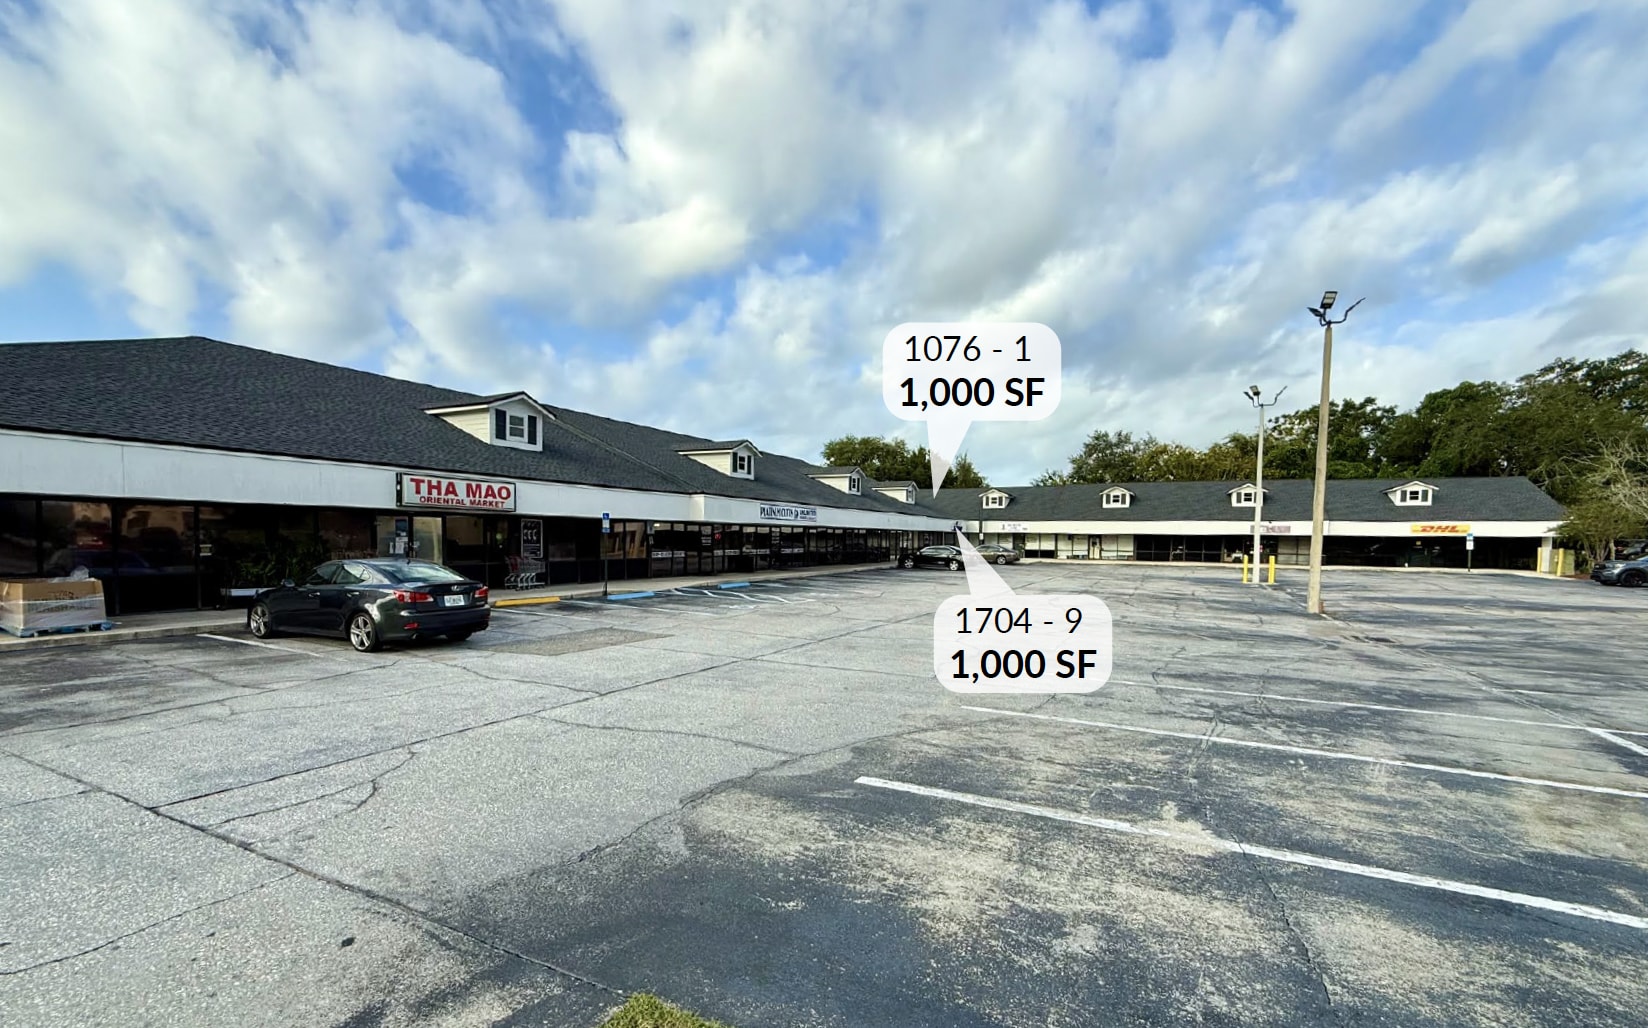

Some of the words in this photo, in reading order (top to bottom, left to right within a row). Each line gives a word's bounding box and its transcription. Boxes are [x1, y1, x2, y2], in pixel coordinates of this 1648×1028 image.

[410, 478, 458, 497] THA
[466, 483, 511, 500] MAO
[419, 495, 466, 506] ORIENTAL
[469, 499, 505, 508] MARKET
[1420, 525, 1459, 533] DHL
